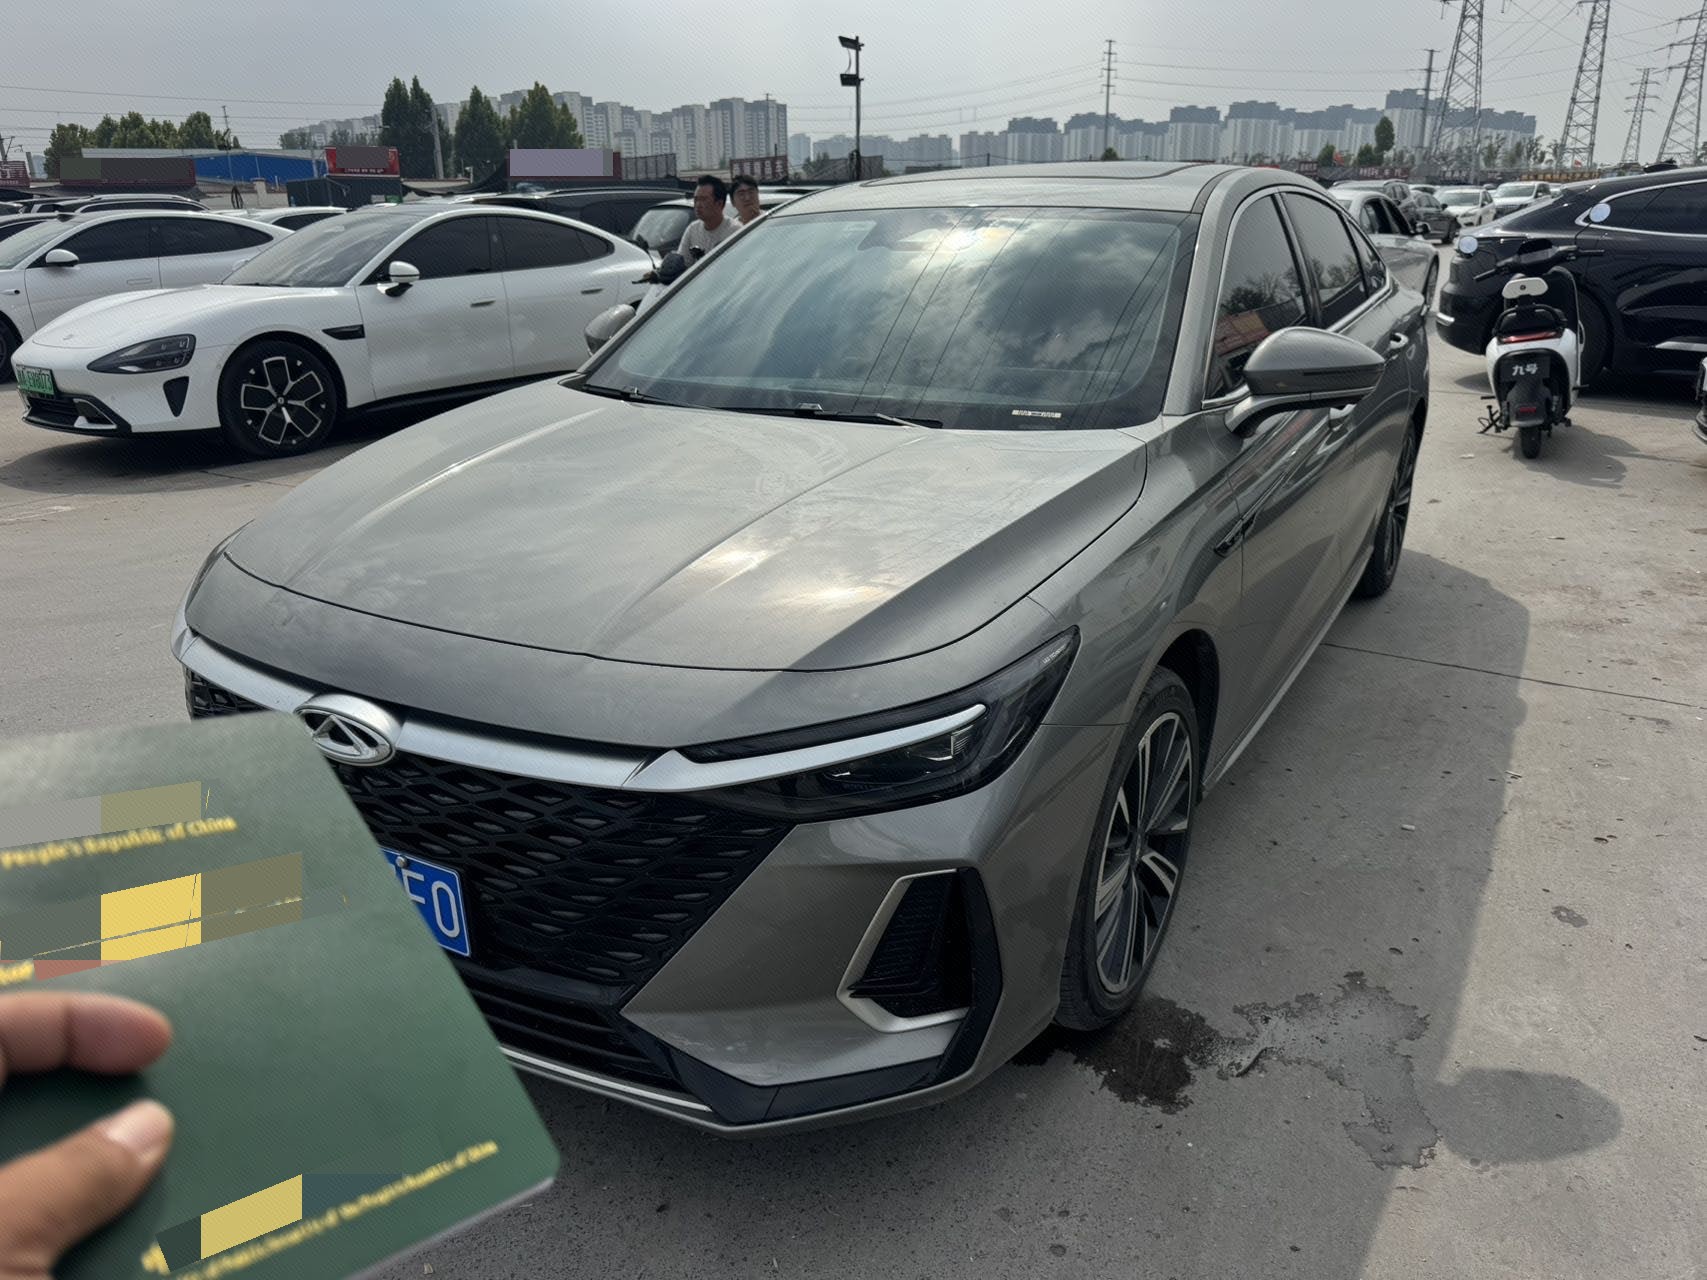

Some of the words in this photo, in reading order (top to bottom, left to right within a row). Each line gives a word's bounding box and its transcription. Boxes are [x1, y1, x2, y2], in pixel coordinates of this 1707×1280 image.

[1512, 363, 1538, 376] 九号
[165, 821, 186, 841] of
[186, 816, 237, 837] China
